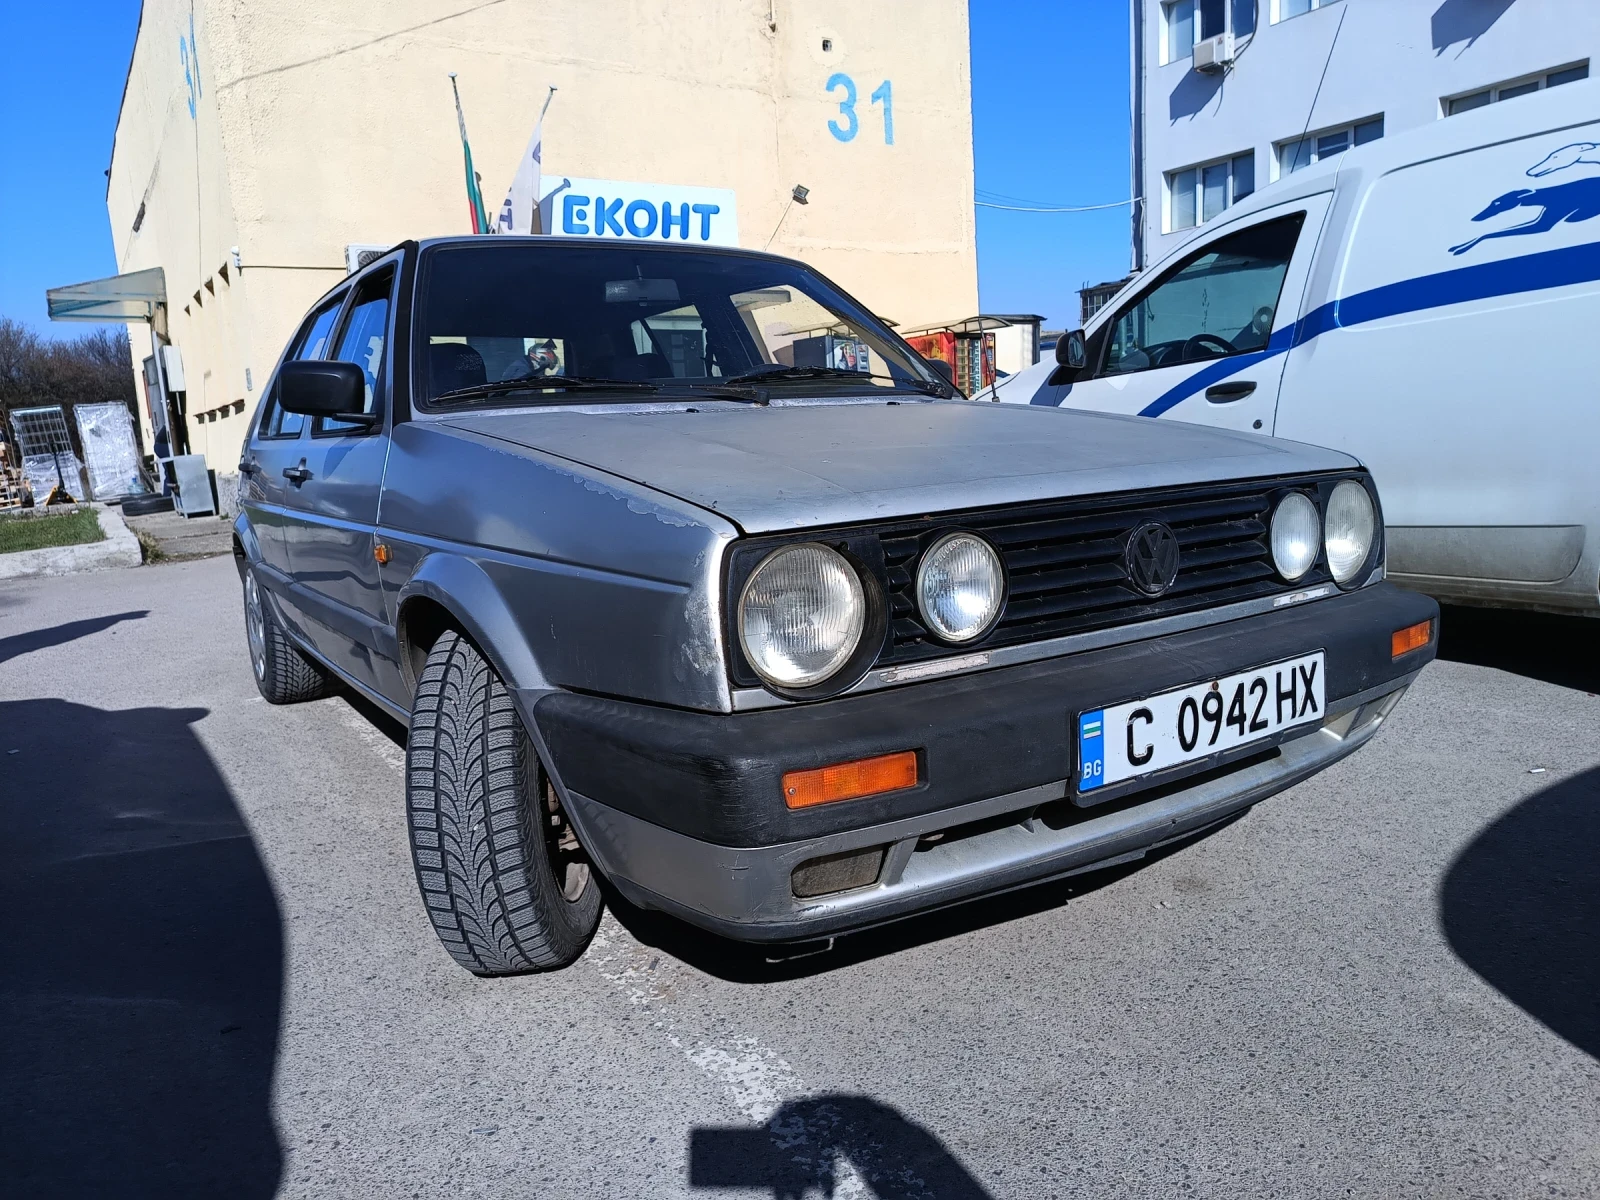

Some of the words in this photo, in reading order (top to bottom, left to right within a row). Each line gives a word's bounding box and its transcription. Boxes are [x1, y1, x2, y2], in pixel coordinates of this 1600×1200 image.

[825, 72, 894, 145] 31
[563, 194, 720, 241] ЕКОНТ
[1083, 759, 1102, 779] BG
